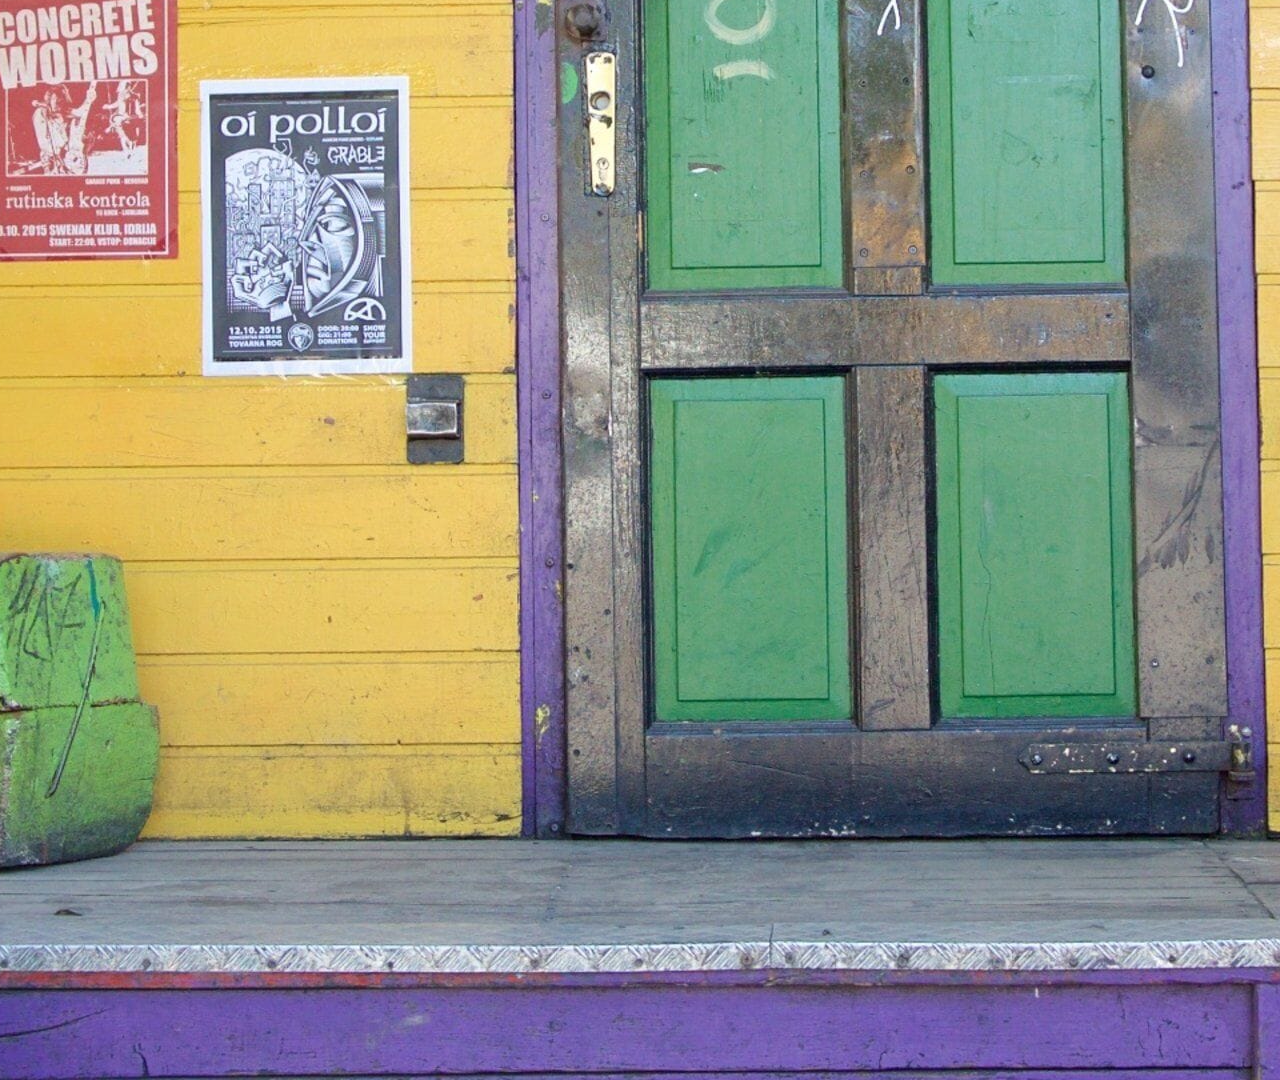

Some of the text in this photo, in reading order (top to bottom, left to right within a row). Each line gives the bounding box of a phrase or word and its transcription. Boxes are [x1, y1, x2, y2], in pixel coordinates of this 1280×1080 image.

[6, 191, 150, 209] rutinska kontrola
[22, 224, 47, 236] 2015
[49, 224, 92, 236] SWENAK
[124, 223, 157, 235] IDRIJA
[229, 326, 282, 335] 12.10. 2015
[229, 340, 265, 348] TOVARNA
